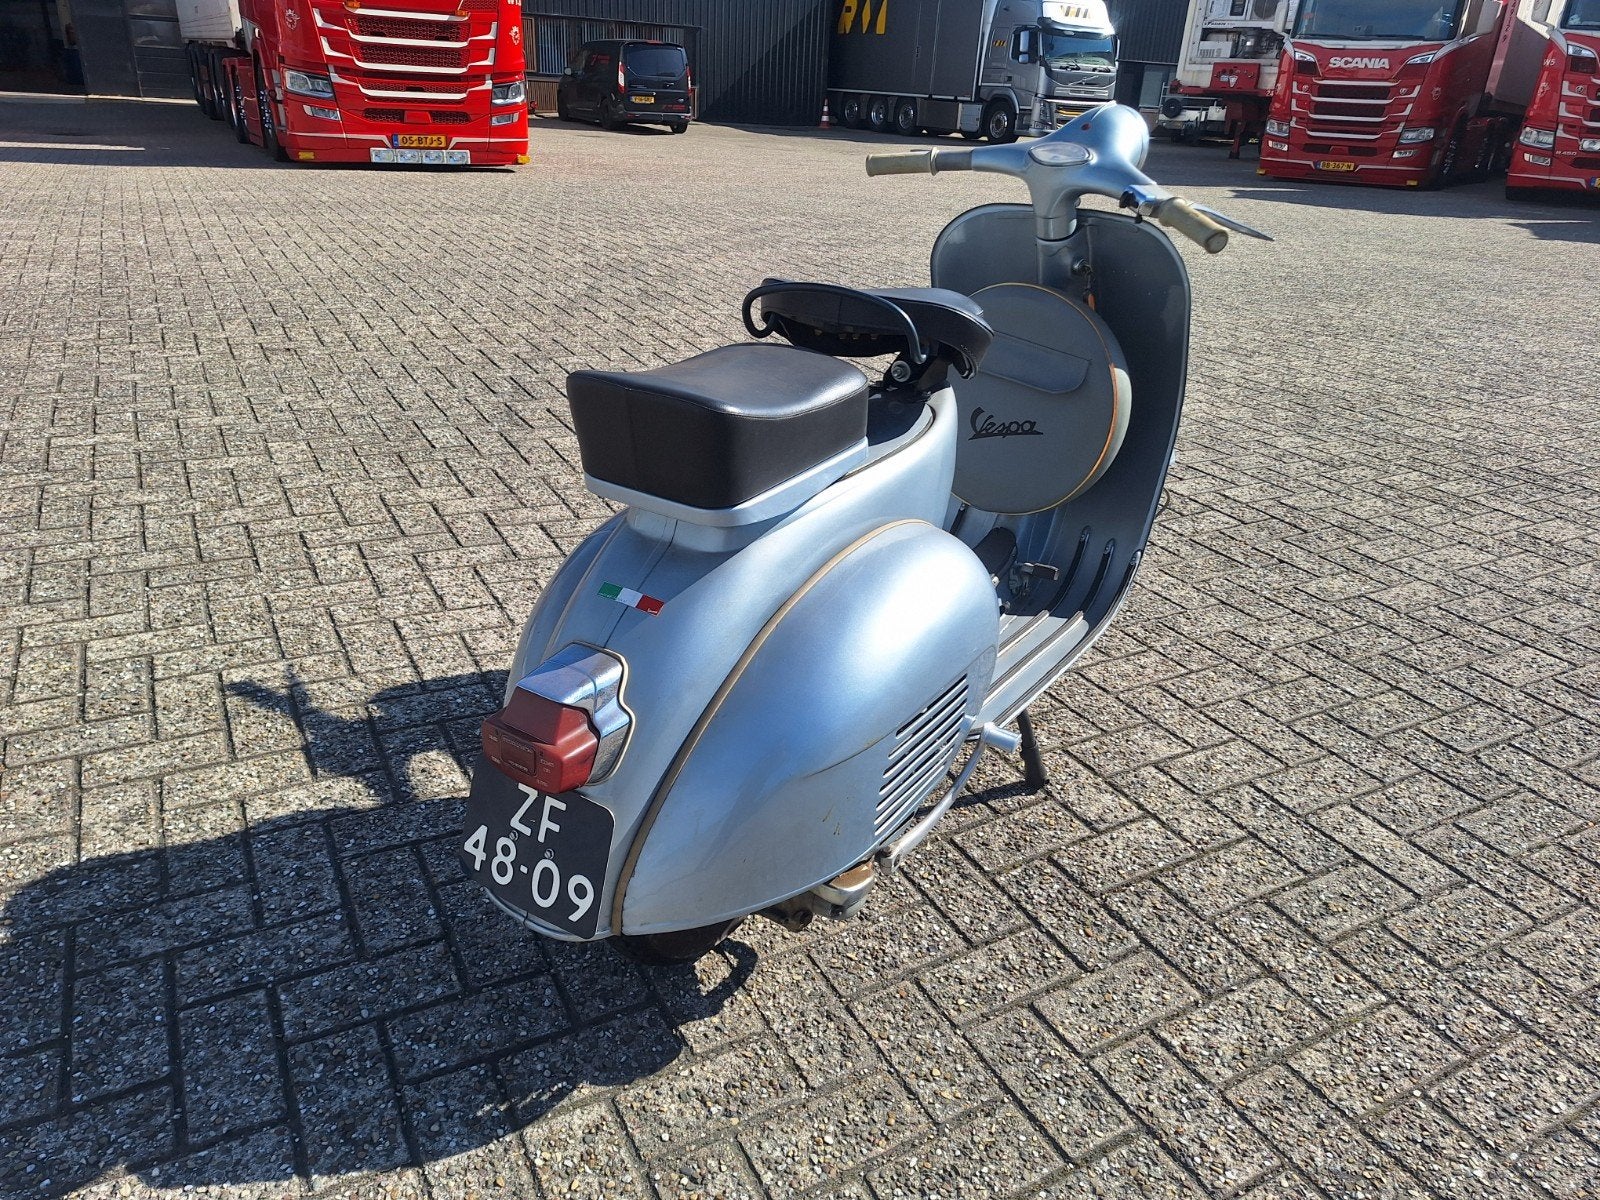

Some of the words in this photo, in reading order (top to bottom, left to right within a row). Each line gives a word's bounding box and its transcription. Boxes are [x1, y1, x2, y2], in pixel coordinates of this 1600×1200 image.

[1328, 56, 1390, 69] SCANIA
[968, 406, 1044, 441] Vespa
[509, 782, 567, 843] ZF
[463, 824, 595, 923] 48-09
